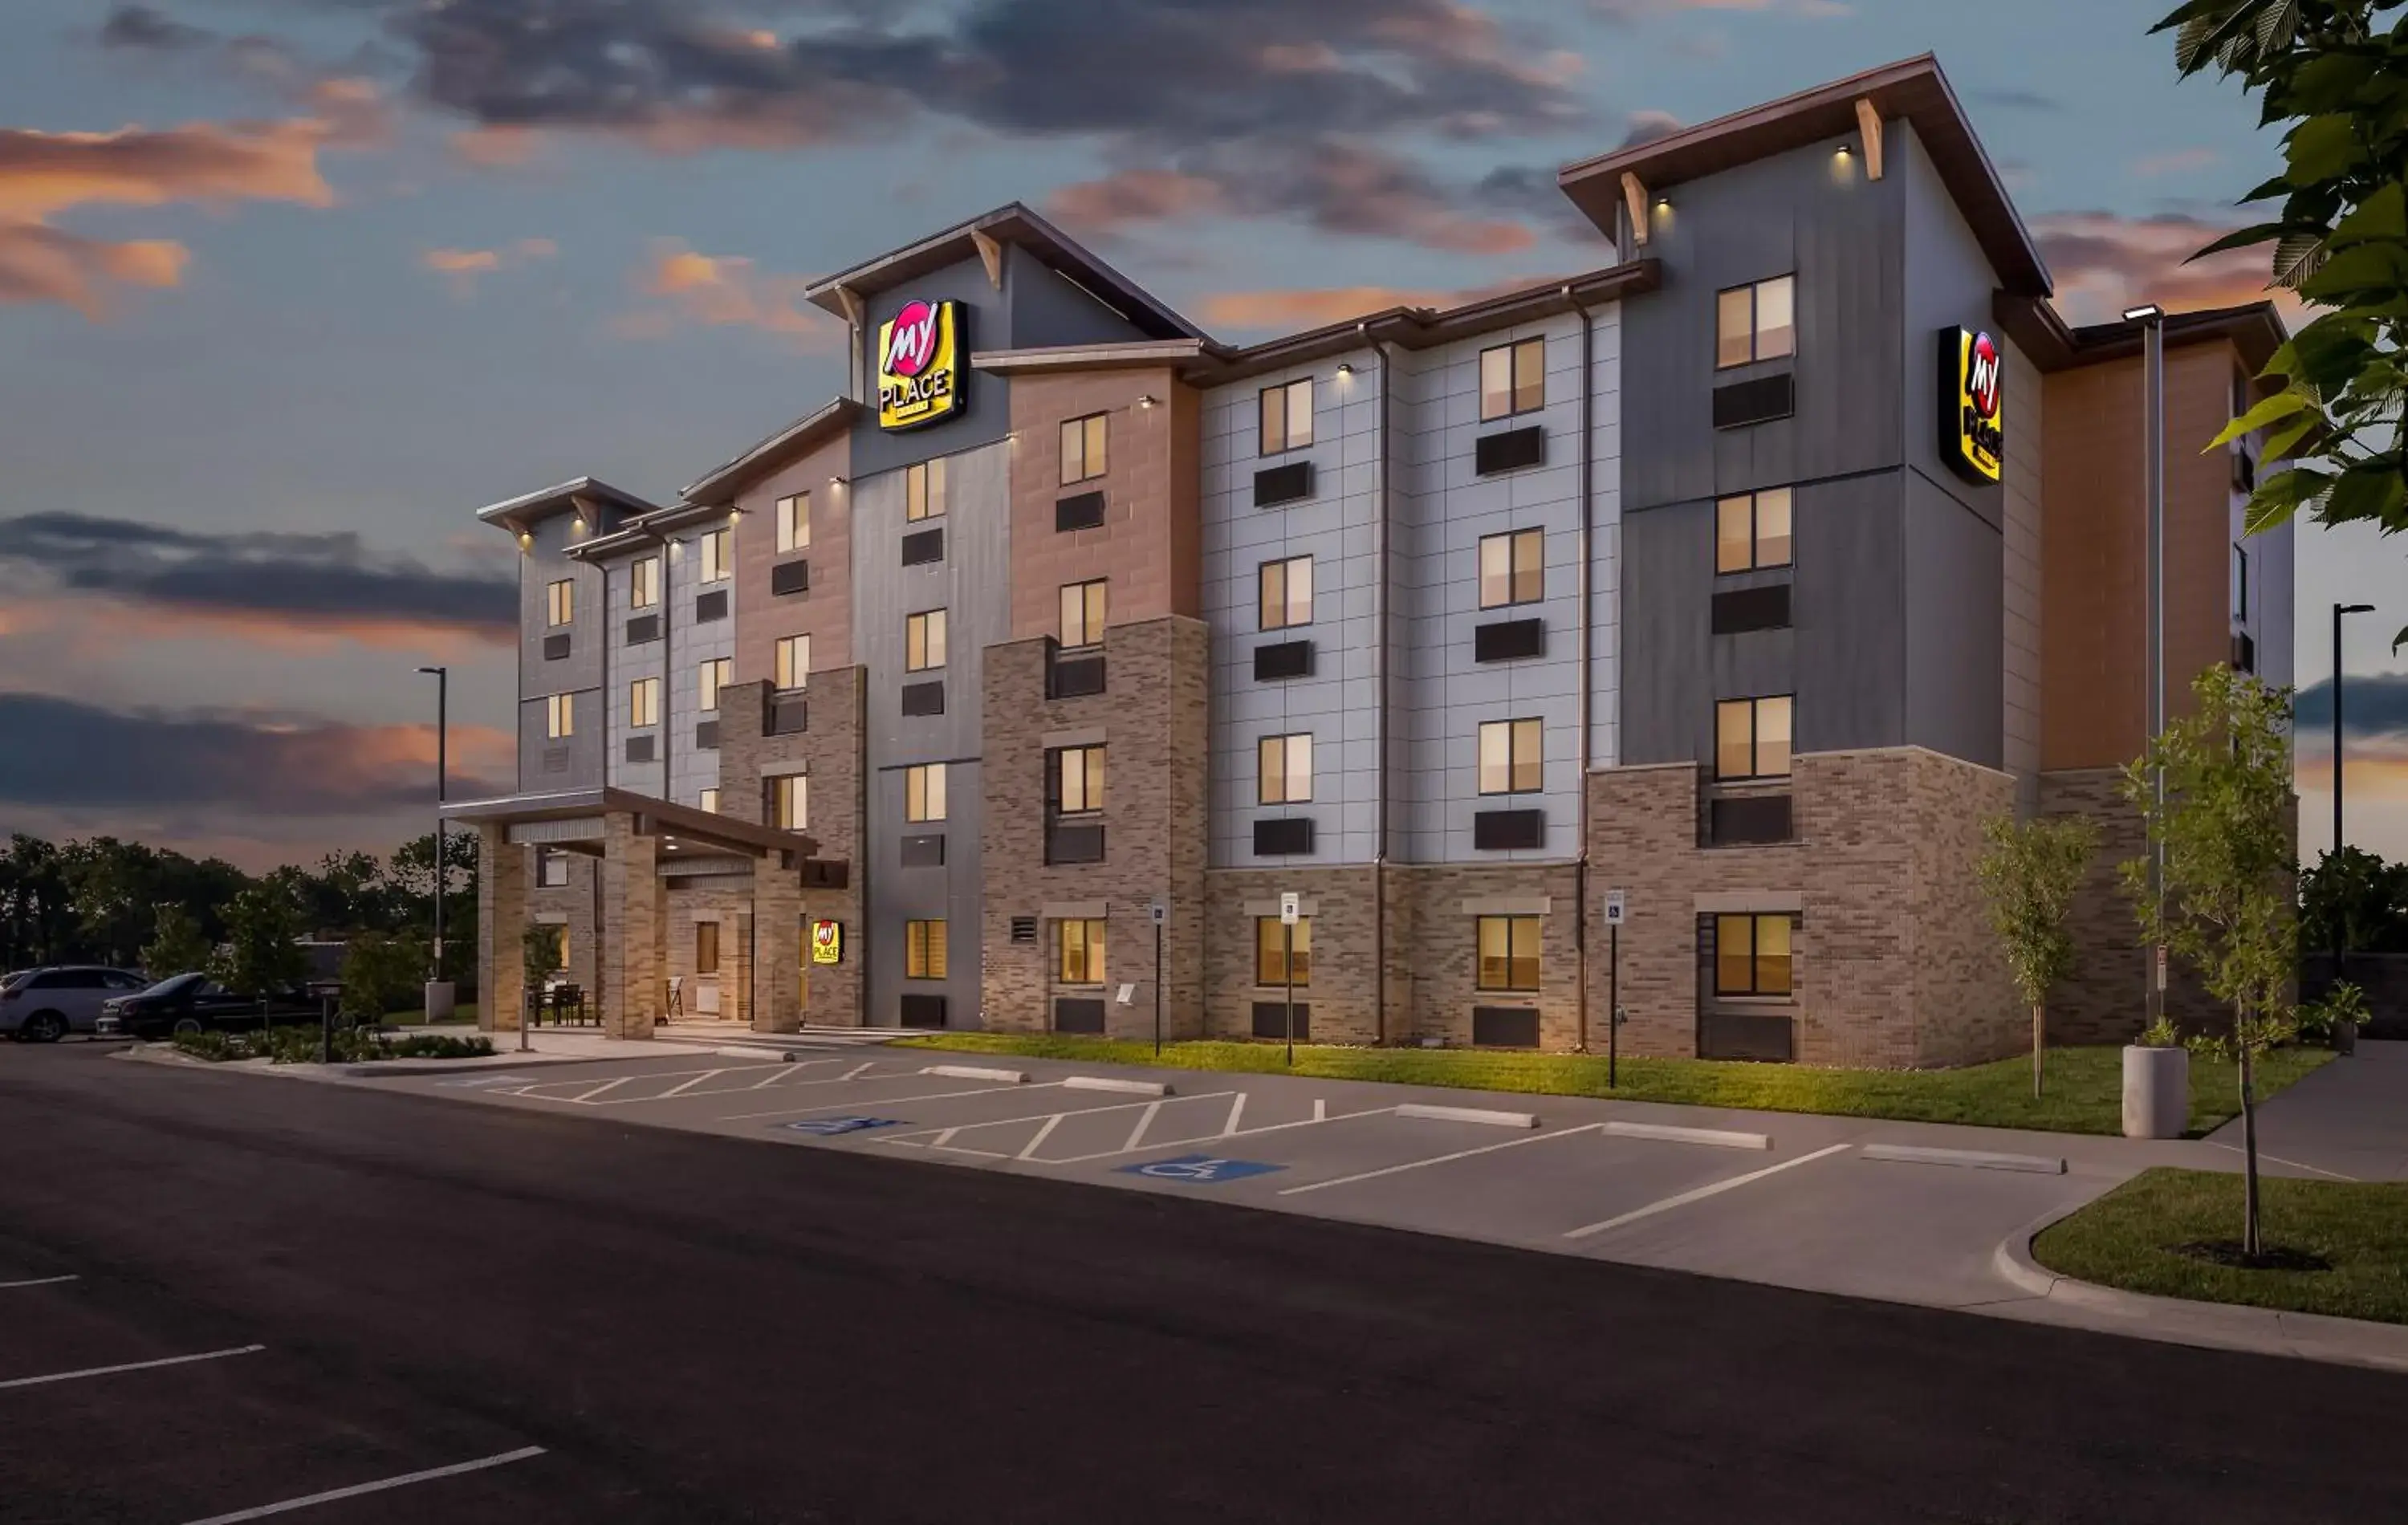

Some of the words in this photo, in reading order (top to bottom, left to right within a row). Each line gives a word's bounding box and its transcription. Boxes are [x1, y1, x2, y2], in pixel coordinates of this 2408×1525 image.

[885, 300, 938, 372] MY
[881, 369, 947, 412] PLACE
[1971, 353, 1999, 411] MY
